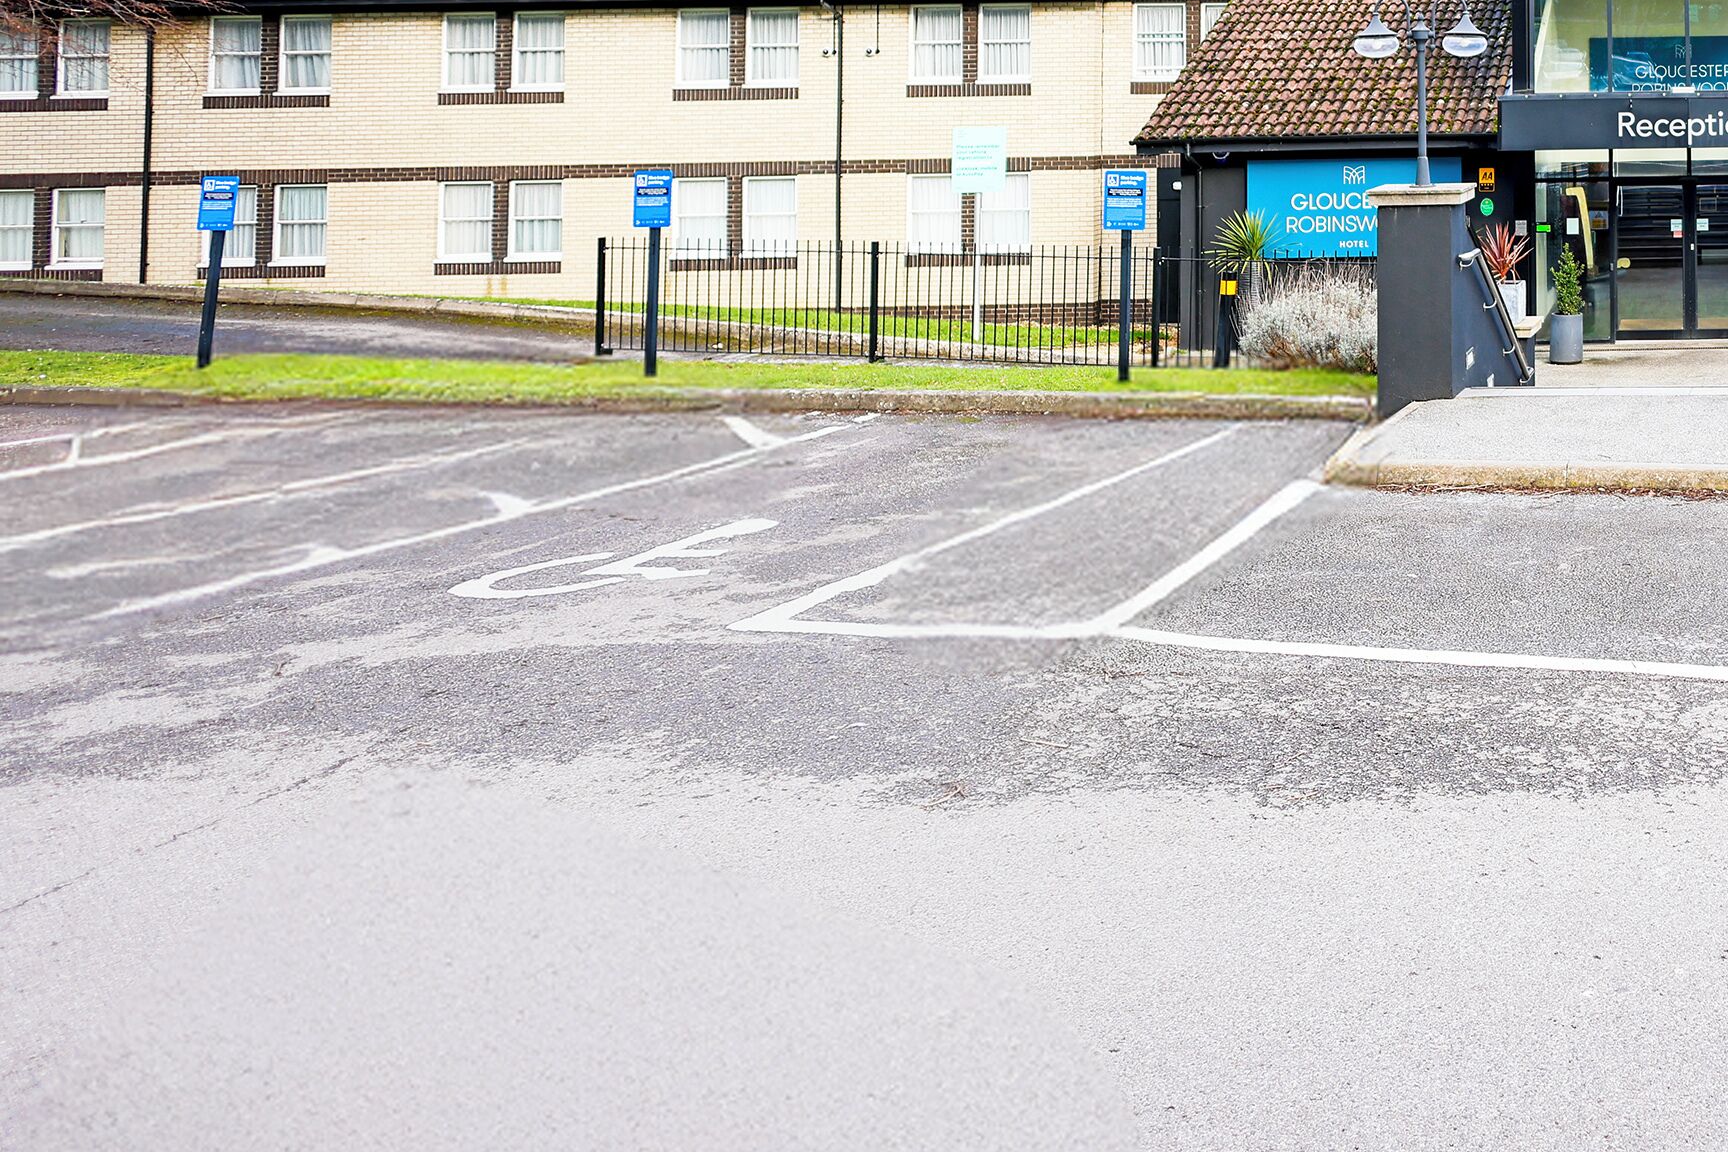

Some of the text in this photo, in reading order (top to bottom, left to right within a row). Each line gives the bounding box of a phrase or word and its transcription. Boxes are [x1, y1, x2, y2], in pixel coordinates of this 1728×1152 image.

[1481, 171, 1493, 181] AA
[1290, 192, 1378, 212] GLOUCE
[1286, 215, 1378, 233] ROBINSW
[1339, 240, 1369, 249] HOTEL
